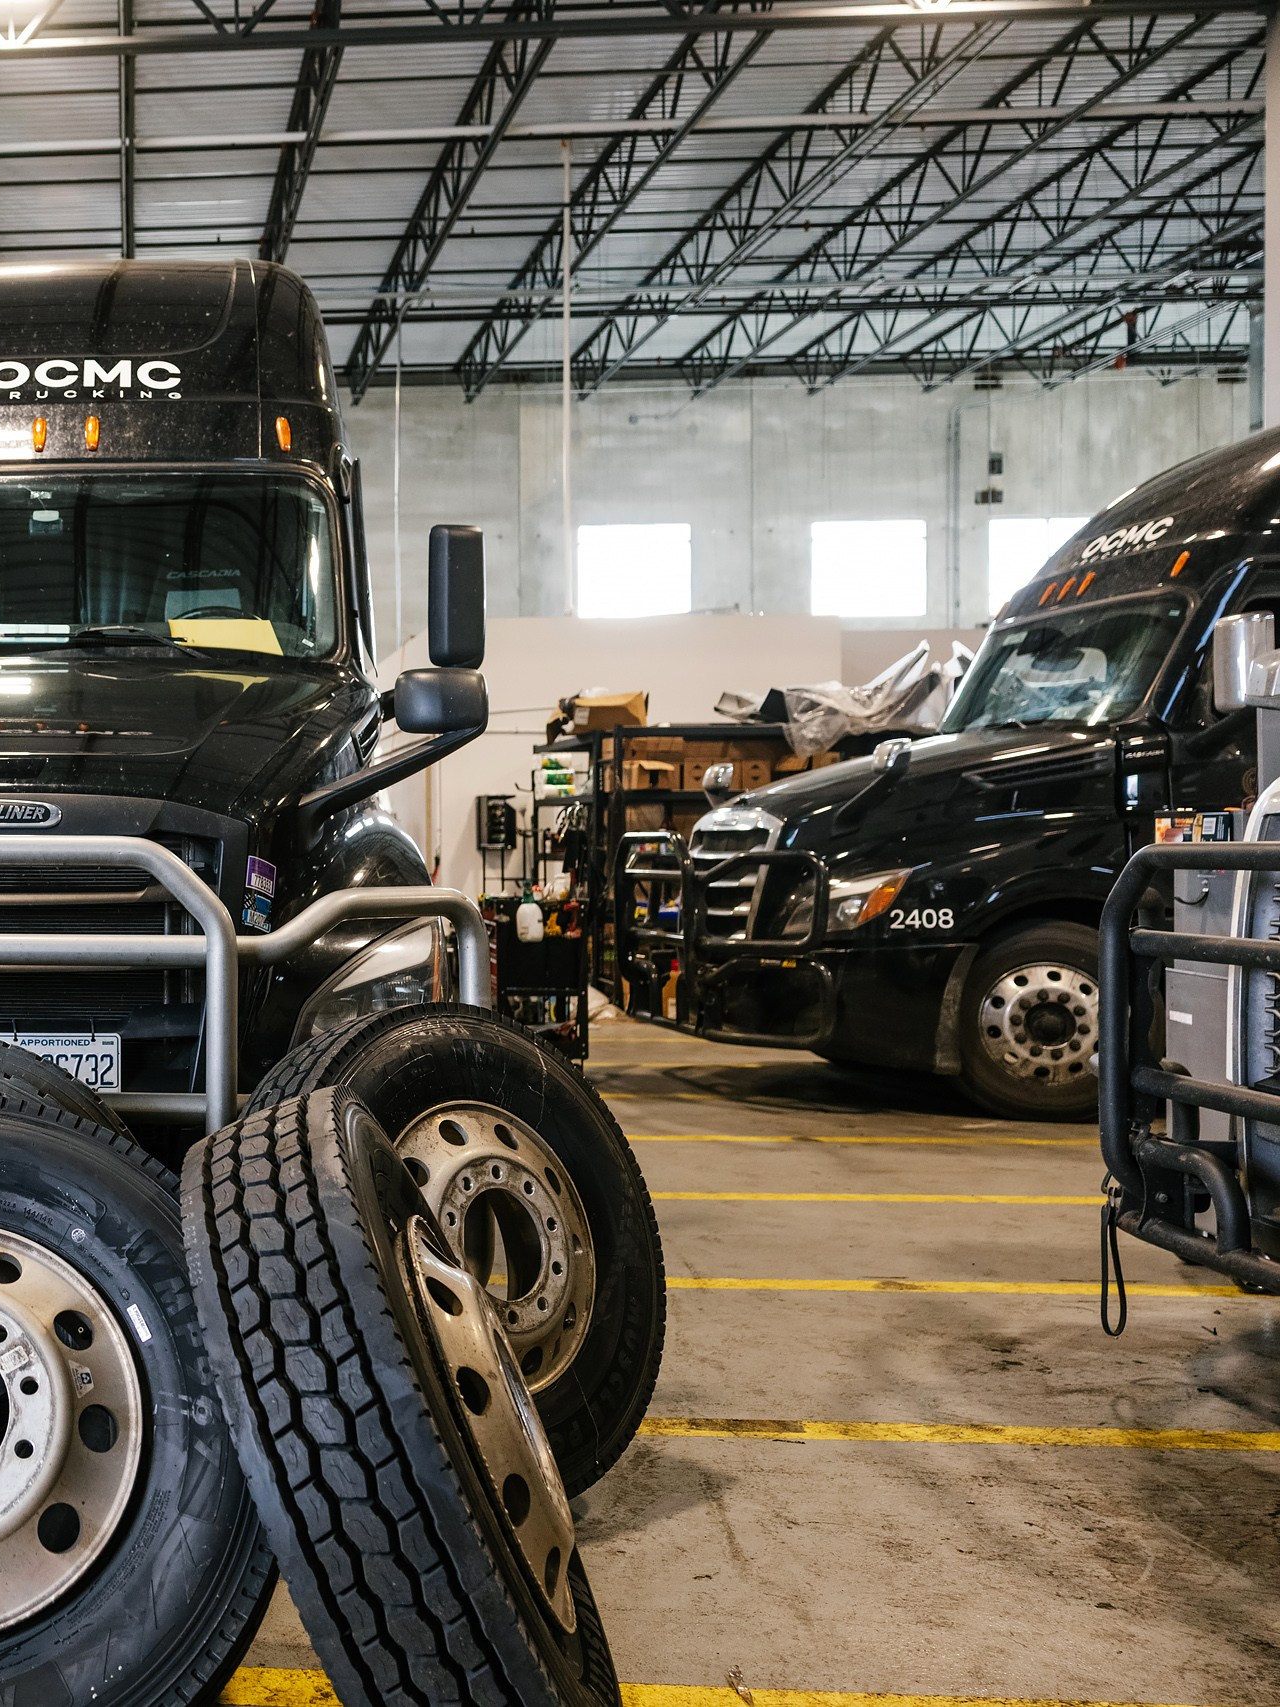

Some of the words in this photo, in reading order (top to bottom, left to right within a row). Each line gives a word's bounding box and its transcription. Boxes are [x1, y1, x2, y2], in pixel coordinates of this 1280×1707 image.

[1081, 516, 1174, 559] OCMC
[166, 569, 240, 579] CASCADIA
[889, 908, 955, 929] 2408
[20, 1039, 91, 1047] APPORTIONED
[41, 1054, 114, 1086] 732
